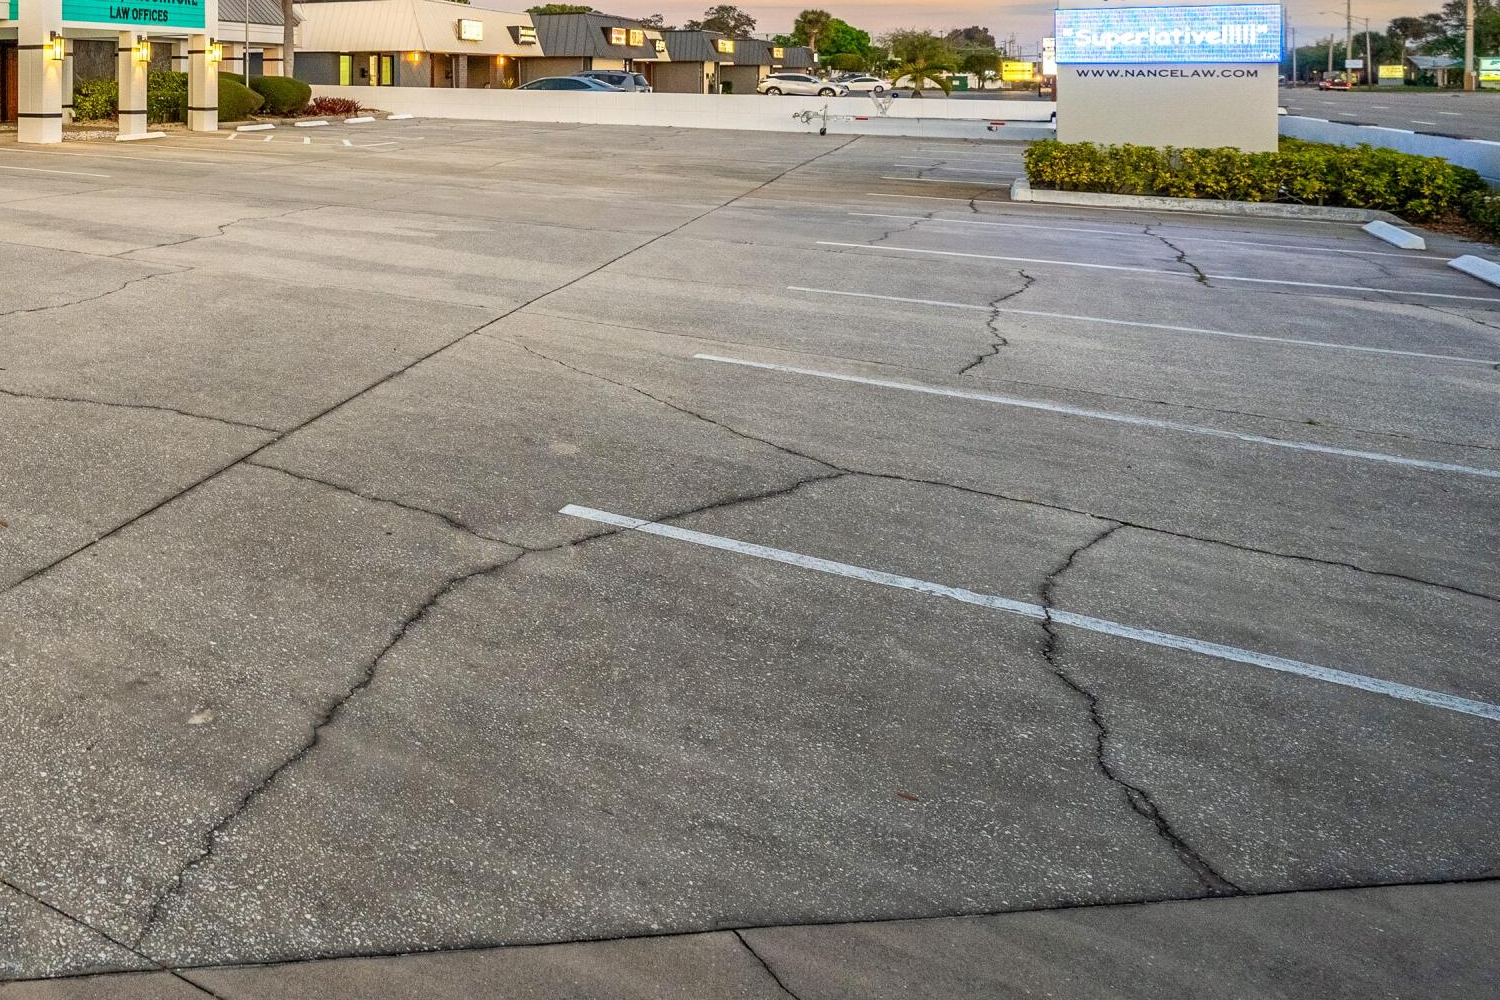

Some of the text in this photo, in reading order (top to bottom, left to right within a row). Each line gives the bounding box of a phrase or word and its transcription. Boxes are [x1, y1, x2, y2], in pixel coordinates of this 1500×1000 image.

[109, 6, 169, 22] LAW OFFICES
[1075, 69, 1259, 79] WWW.NANCELAW.COM
